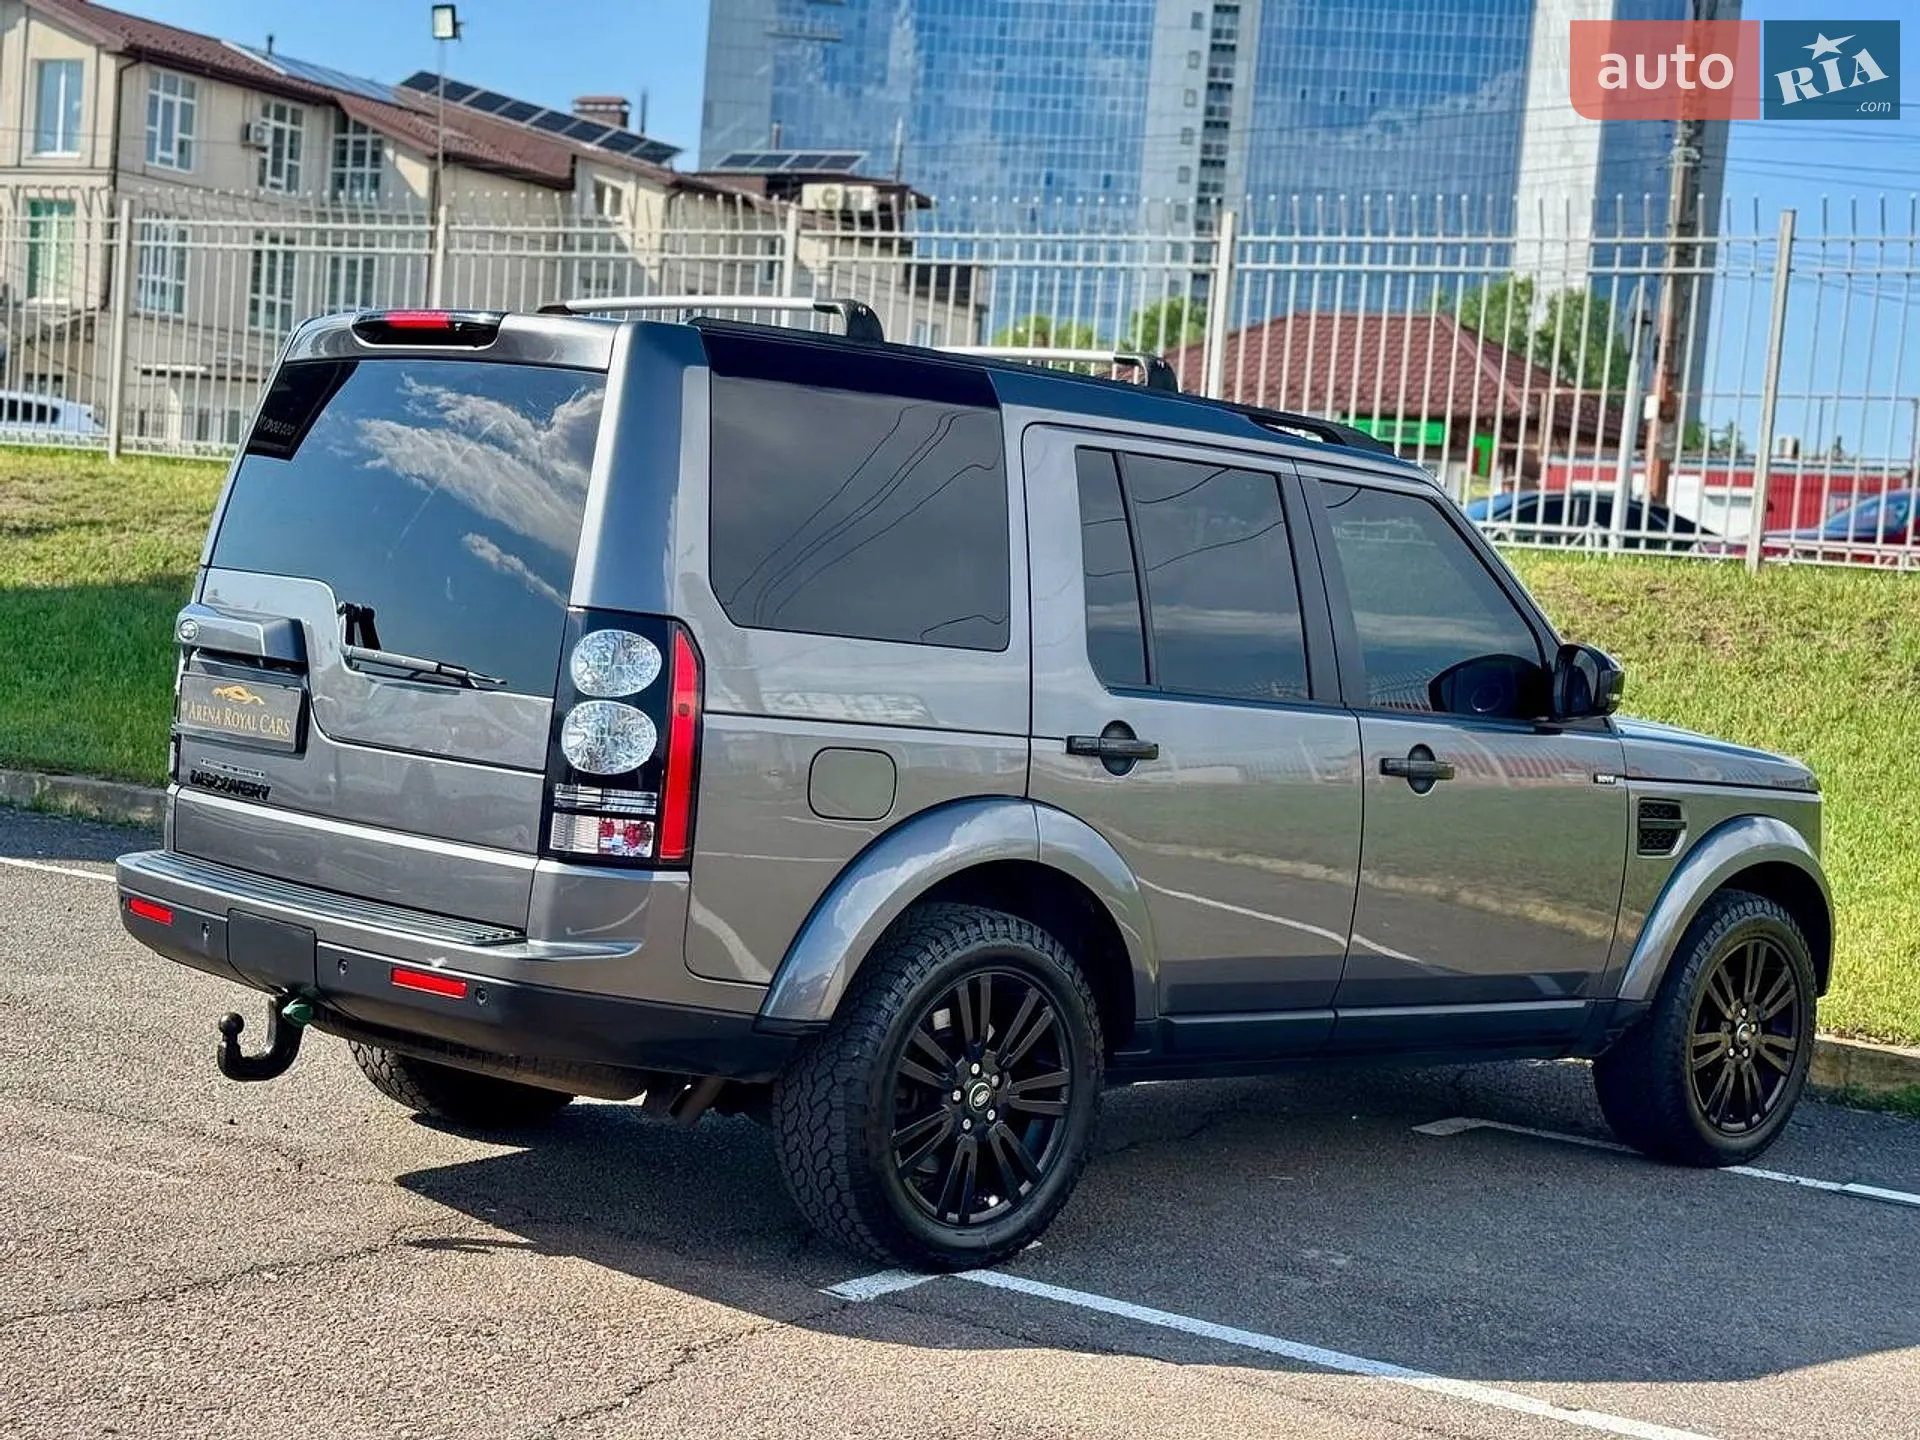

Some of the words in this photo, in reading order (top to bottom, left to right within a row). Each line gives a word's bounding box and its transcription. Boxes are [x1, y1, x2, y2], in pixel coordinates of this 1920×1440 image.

[188, 700, 221, 725] ARENA
[223, 707, 257, 730] ROYAL
[260, 714, 291, 736] CARS
